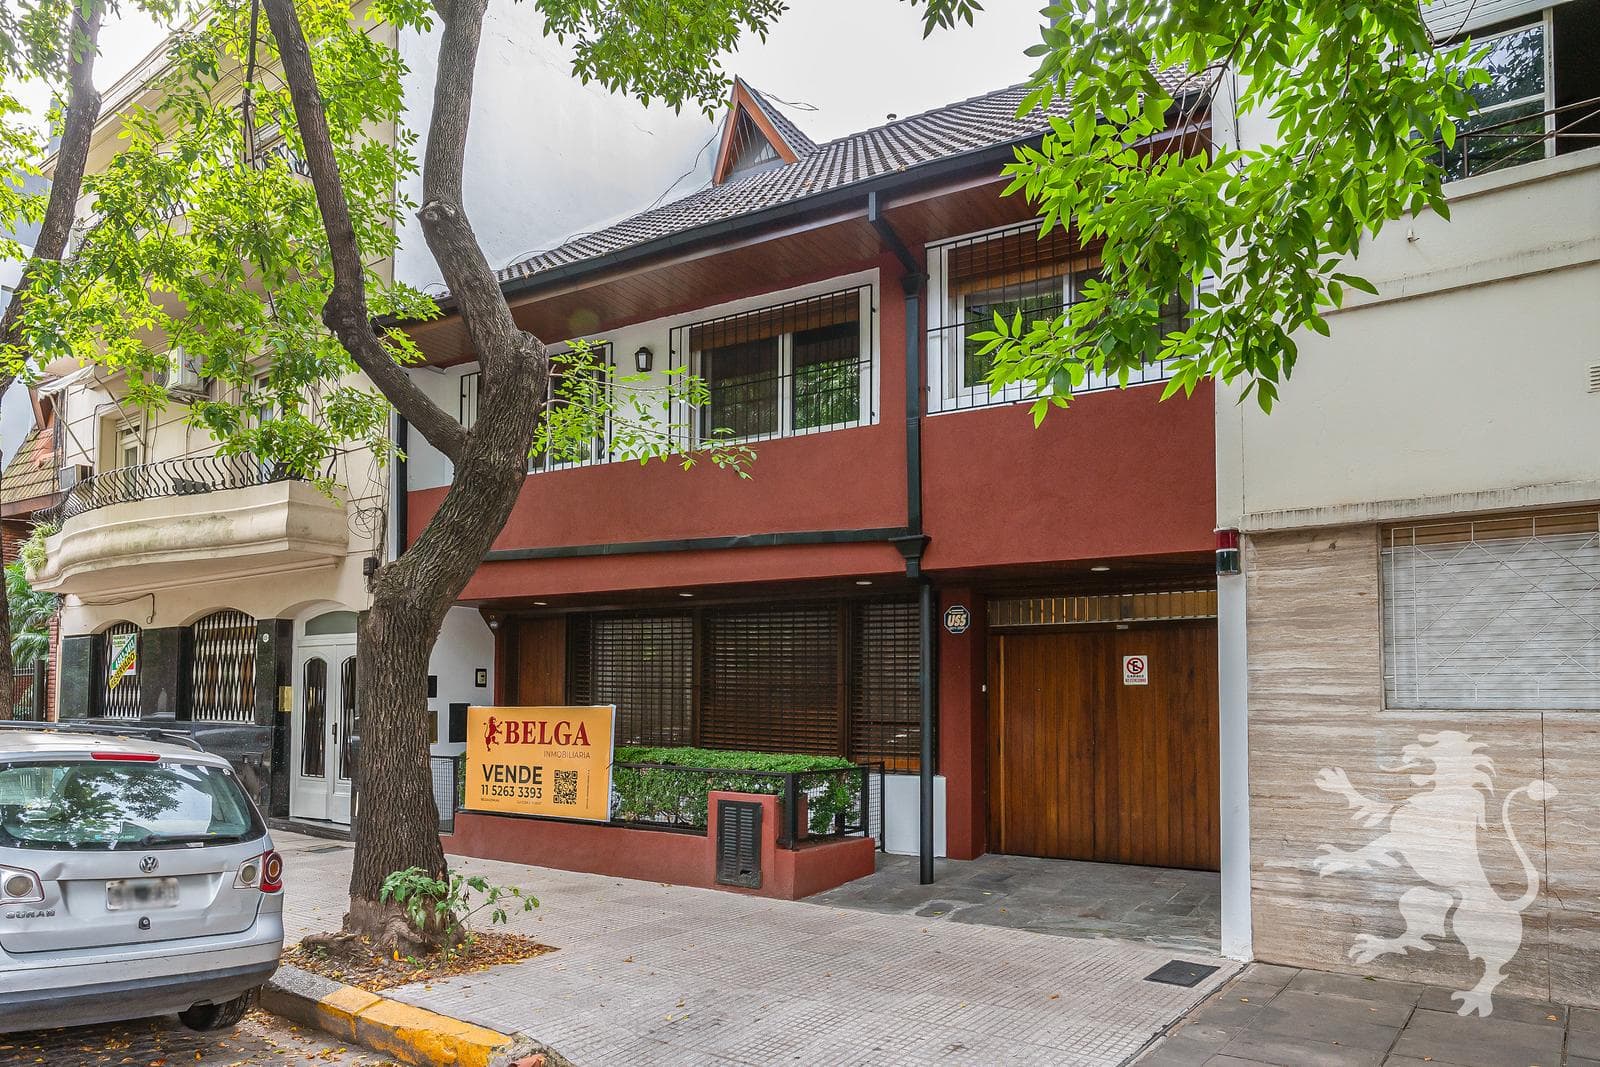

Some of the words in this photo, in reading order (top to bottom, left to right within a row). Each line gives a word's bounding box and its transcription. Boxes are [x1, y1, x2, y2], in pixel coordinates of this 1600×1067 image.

[947, 614, 967, 626] USS
[504, 721, 591, 746] BELGA
[543, 750, 591, 759] INMOBILIARIA
[481, 763, 543, 784] VENDE
[481, 784, 489, 796] 11
[491, 785, 515, 798] 5263
[517, 786, 543, 799] 3393
[5, 909, 56, 919] SURAN
